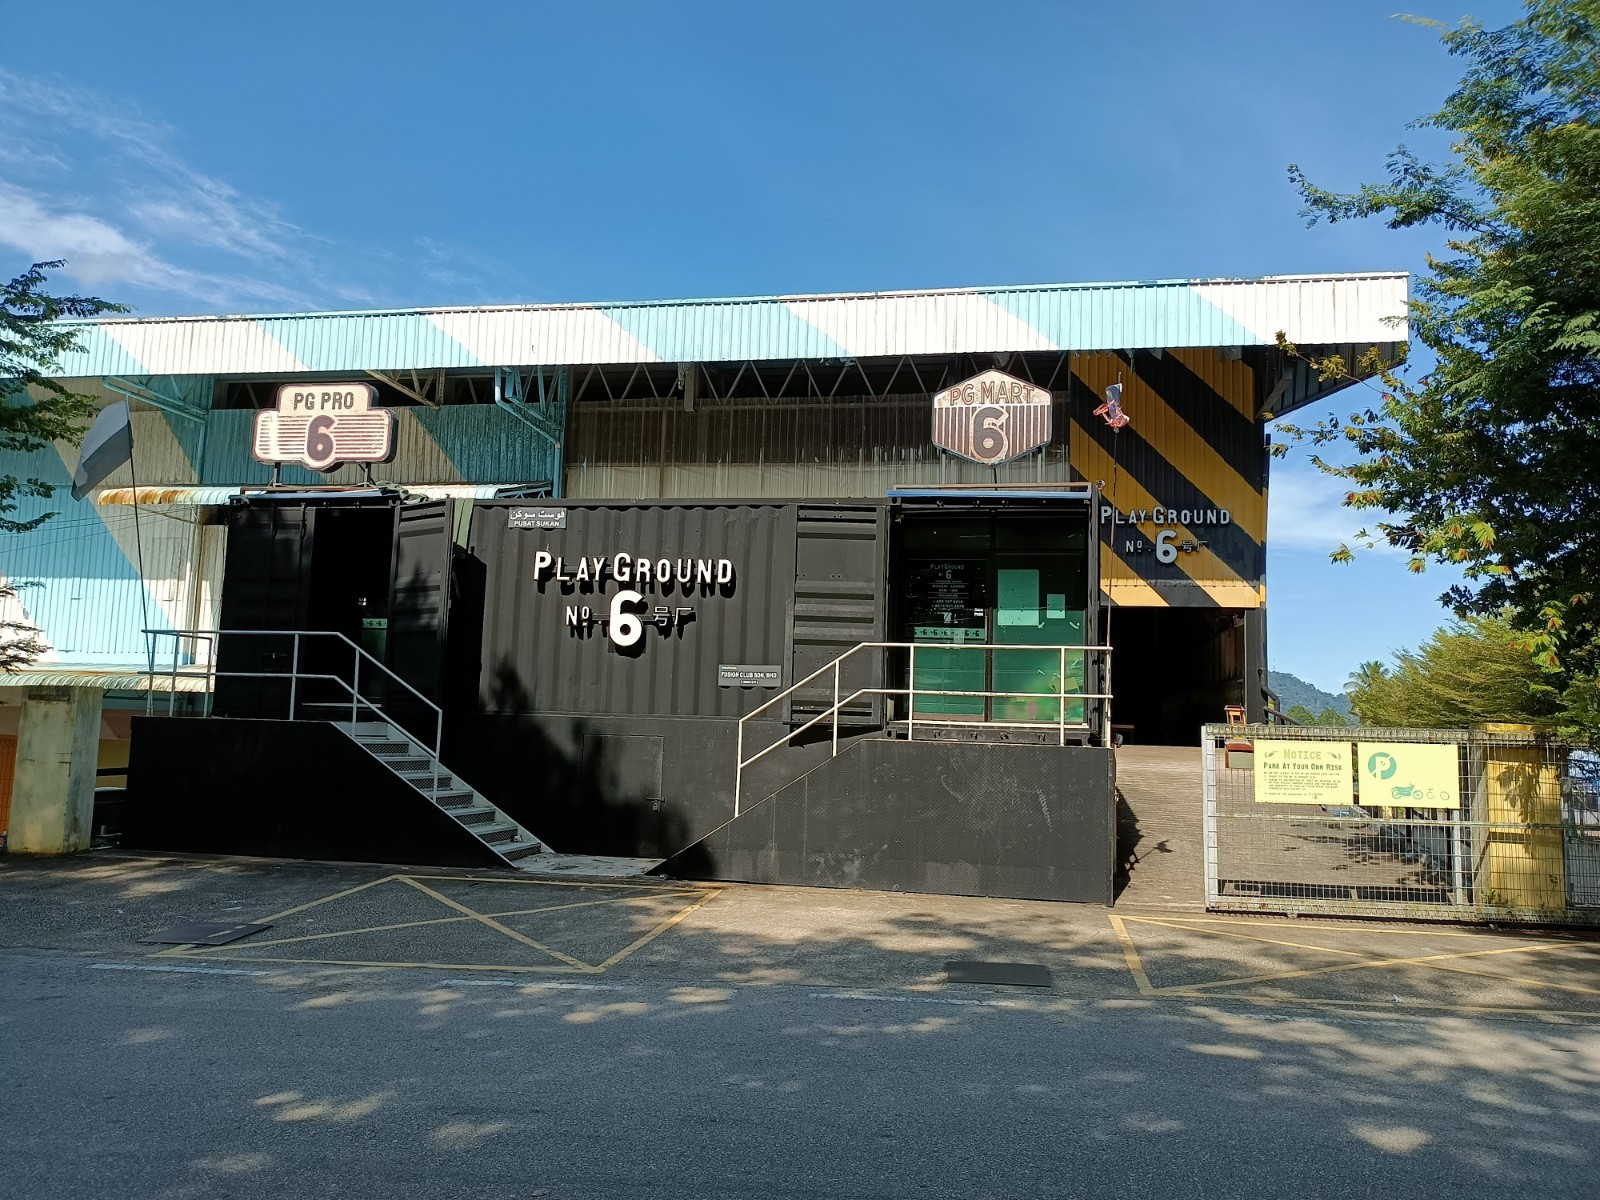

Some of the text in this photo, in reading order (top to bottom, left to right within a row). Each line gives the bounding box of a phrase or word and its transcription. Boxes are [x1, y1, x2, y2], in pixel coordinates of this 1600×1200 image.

[293, 391, 354, 410] PG PRO
[950, 380, 1035, 406] PG MART
[306, 414, 336, 461] 6
[973, 406, 1005, 458] 6
[1156, 529, 1178, 564] 6
[609, 590, 645, 647] 6
[1284, 749, 1322, 760] NOTICE
[1326, 763, 1343, 771] RISK
